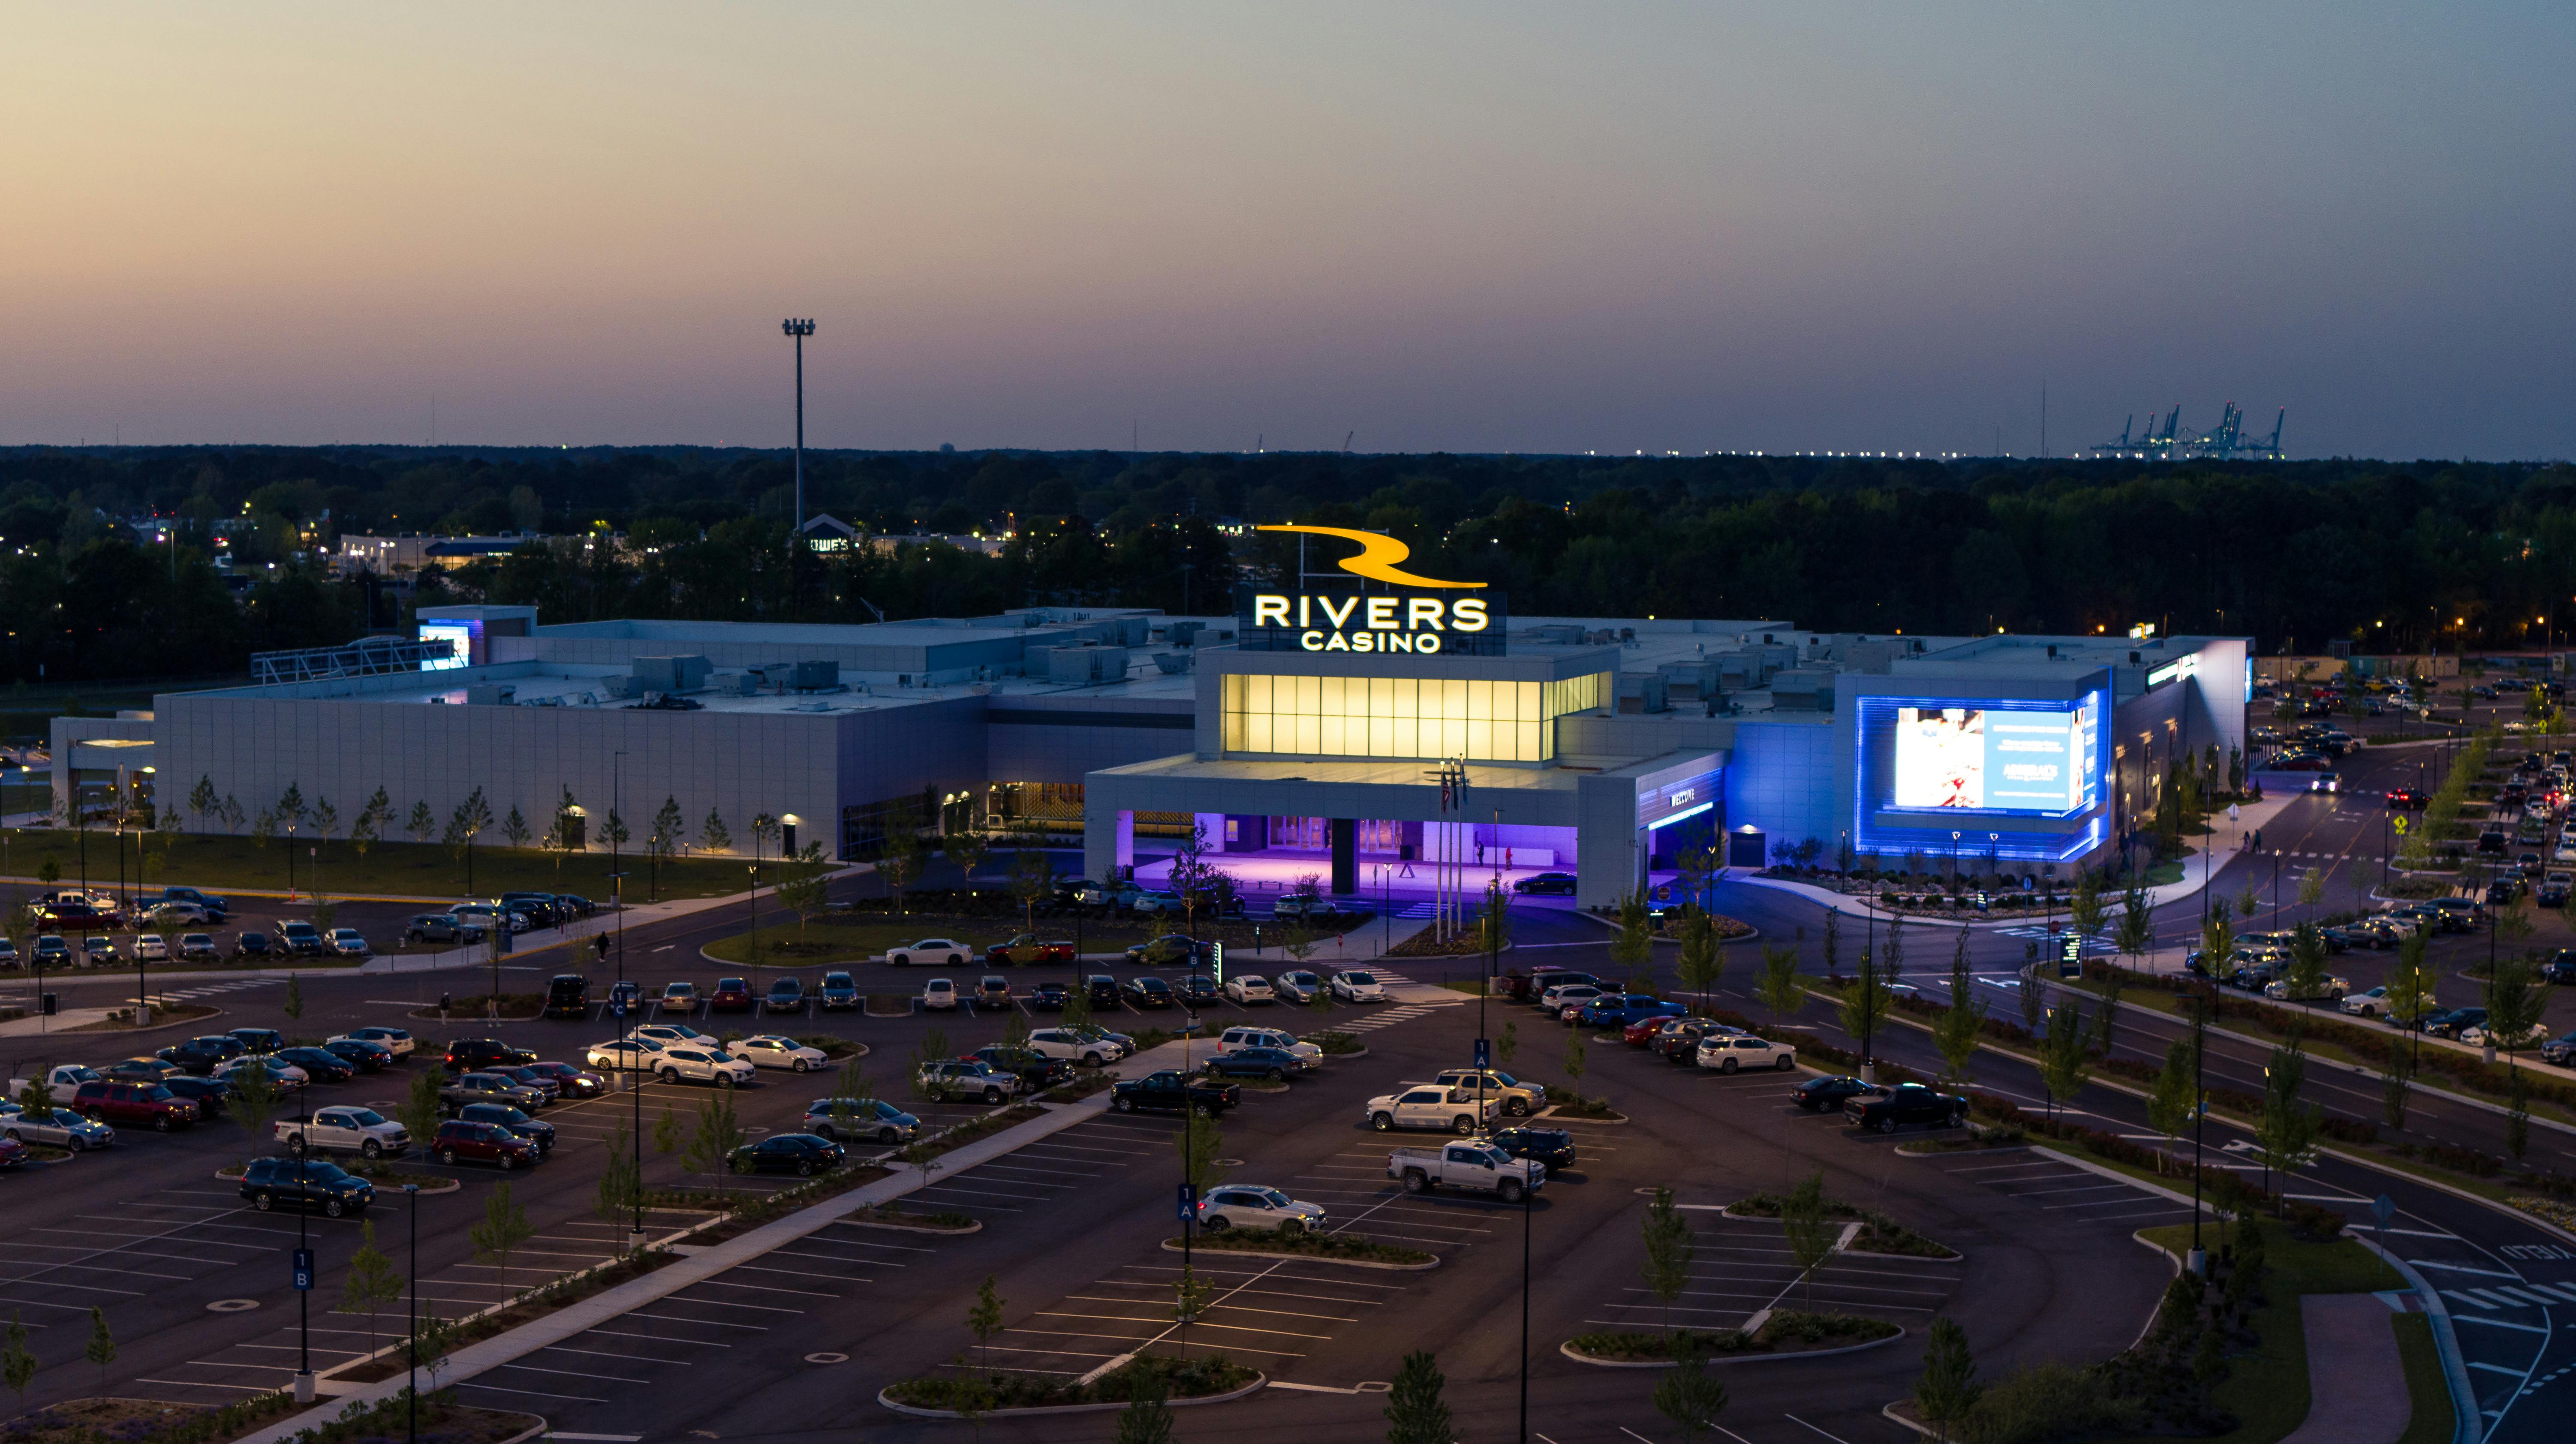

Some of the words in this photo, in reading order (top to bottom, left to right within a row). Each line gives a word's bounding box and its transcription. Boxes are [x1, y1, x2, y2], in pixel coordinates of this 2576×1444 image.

[808, 537, 849, 551] OWE'S
[1255, 595, 1489, 632] RIVERS
[1301, 631, 1441, 653] CASINO
[1671, 788, 1695, 807] WELCOME
[1192, 945, 1196, 953] 1
[1191, 956, 1198, 964] B
[617, 992, 621, 1001] 1
[616, 1005, 623, 1014] C
[1479, 1041, 1484, 1051] 1
[1477, 1056, 1486, 1065] A
[1183, 1187, 1189, 1199] 1
[1181, 1205, 1192, 1217] A
[2500, 1244, 2576, 1260] YIELD
[298, 1253, 304, 1266] 1
[298, 1273, 307, 1286] B
